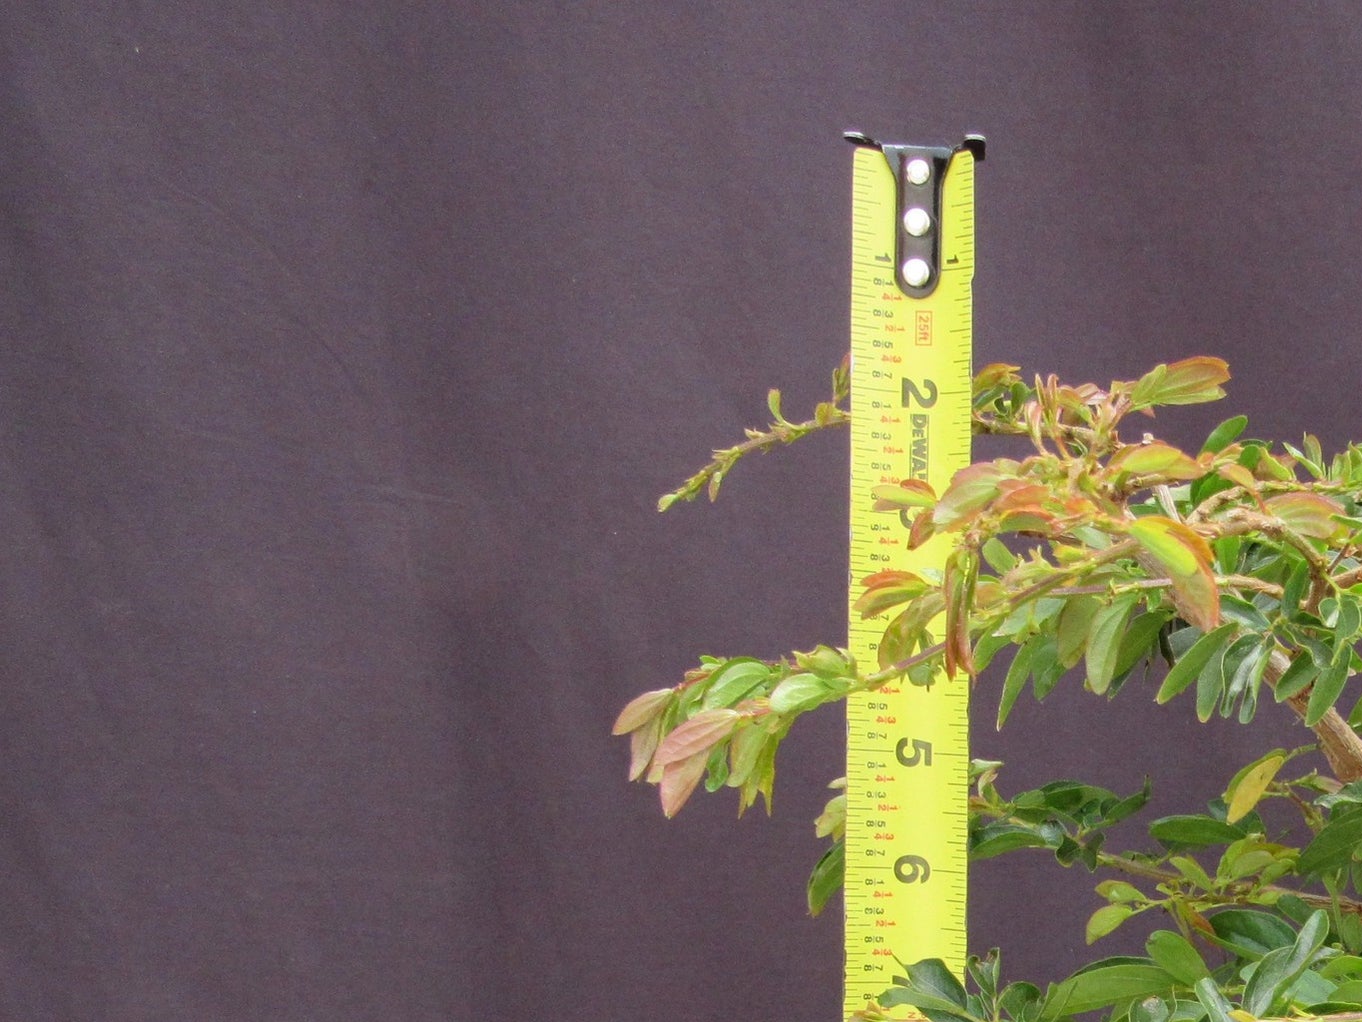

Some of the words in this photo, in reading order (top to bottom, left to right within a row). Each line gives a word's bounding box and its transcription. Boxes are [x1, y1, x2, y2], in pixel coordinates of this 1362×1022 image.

[901, 377, 938, 408] 2
[895, 737, 932, 768] 5
[893, 854, 931, 884] 6
